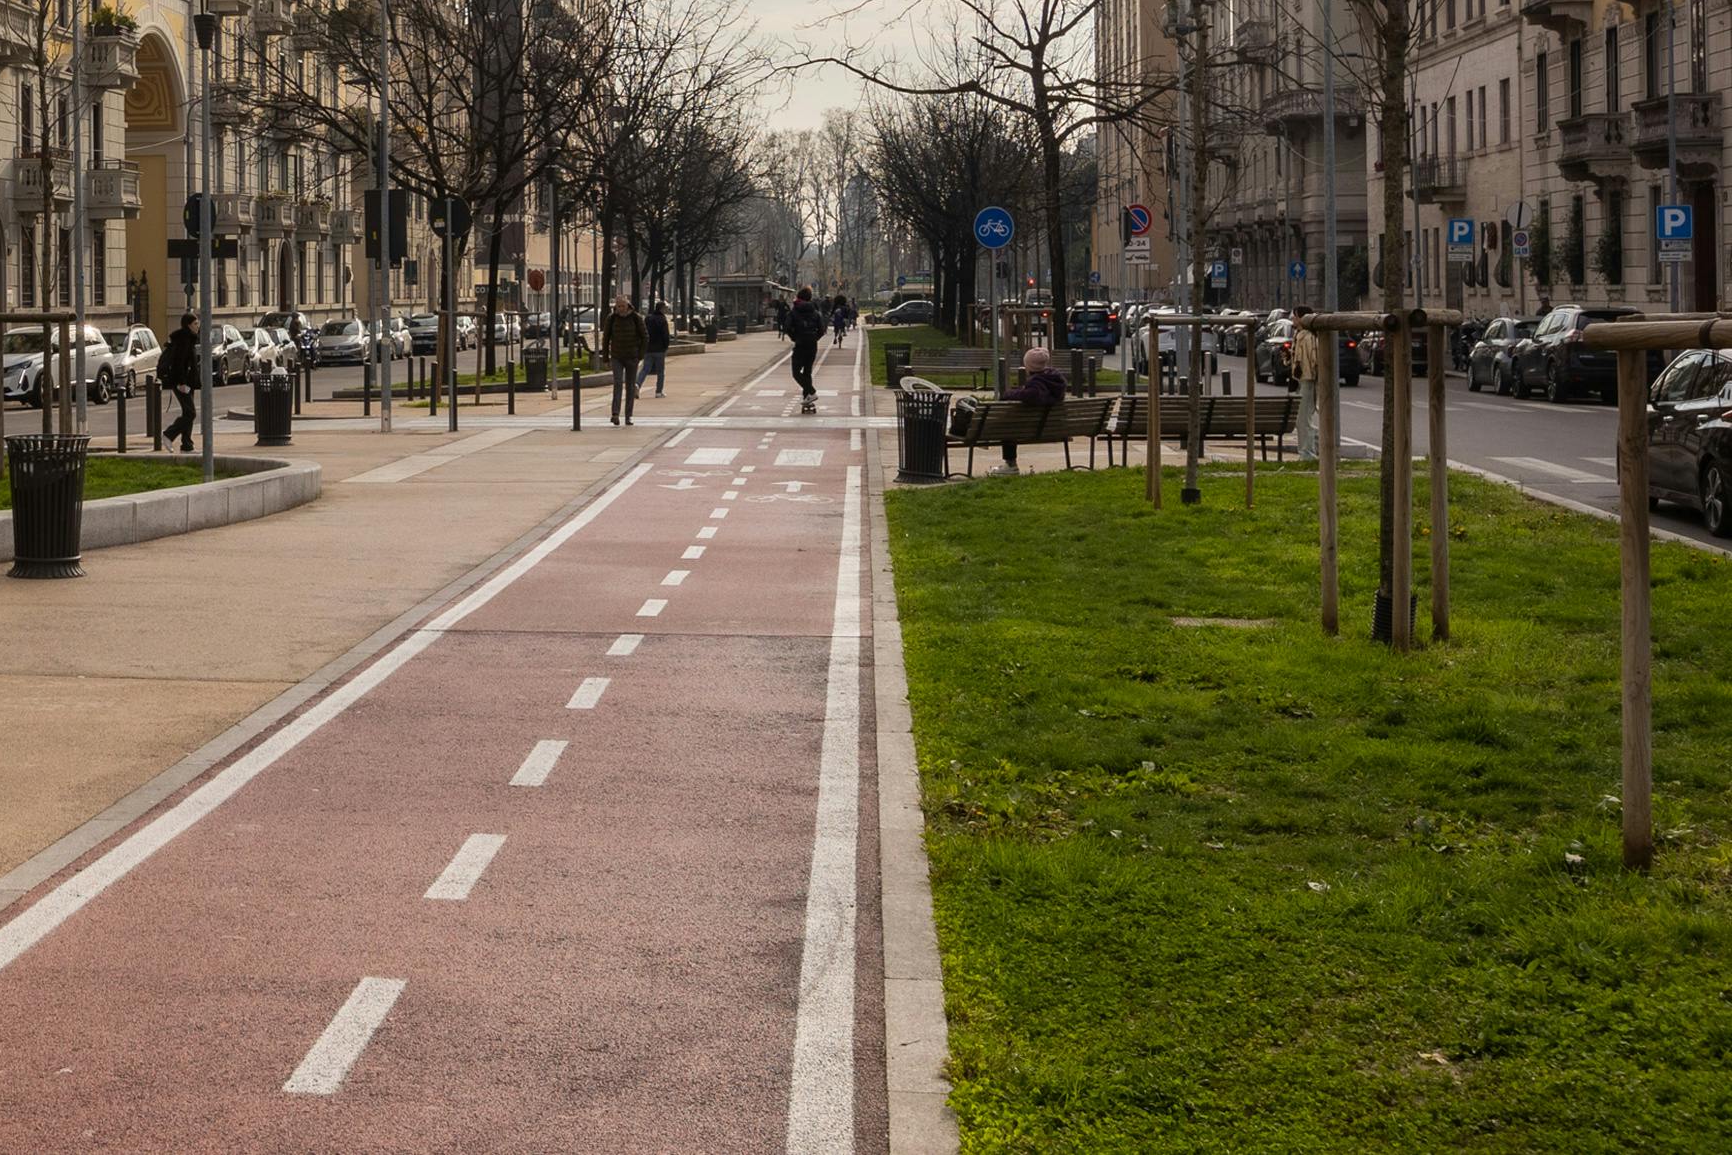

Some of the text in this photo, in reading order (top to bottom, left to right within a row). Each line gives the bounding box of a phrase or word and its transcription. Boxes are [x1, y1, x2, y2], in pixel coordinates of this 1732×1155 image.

[1453, 221, 1470, 242] P
[1664, 209, 1686, 236] P
[1214, 264, 1224, 276] P
